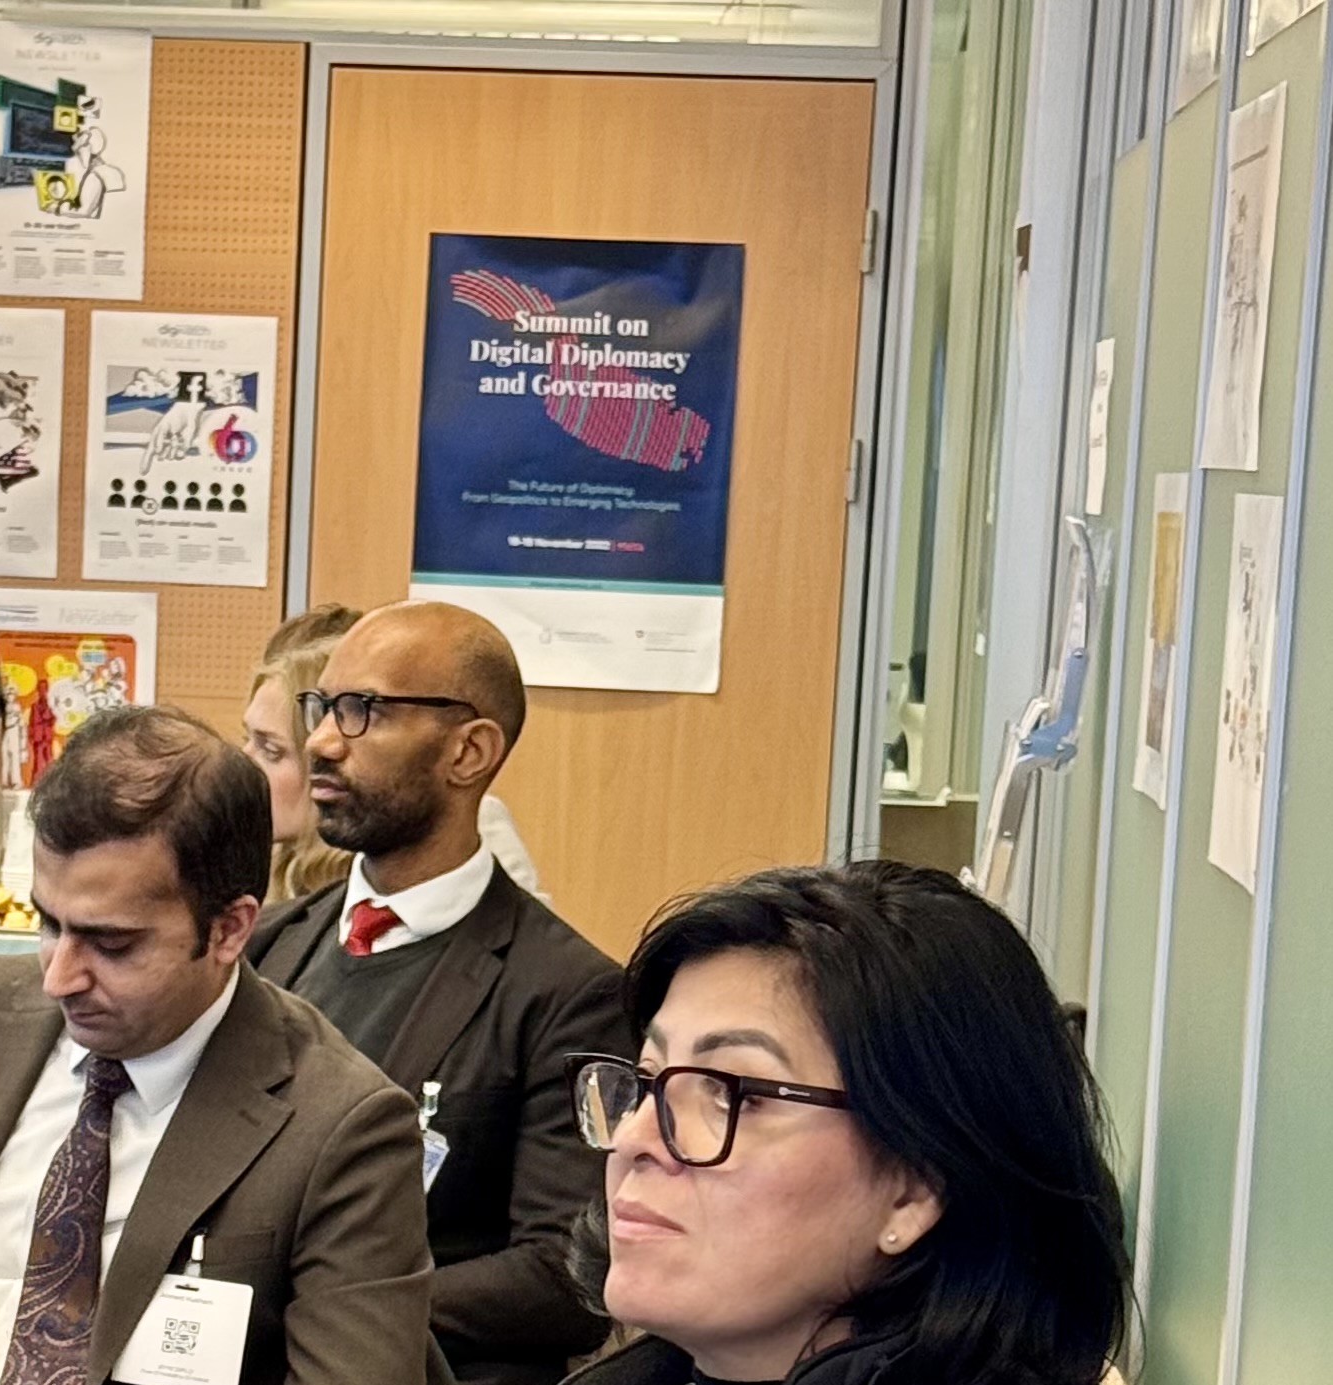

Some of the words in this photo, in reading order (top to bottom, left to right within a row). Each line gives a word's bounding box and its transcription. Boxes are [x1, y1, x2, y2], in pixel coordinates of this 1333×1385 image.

[513, 310, 612, 336] Summit
[617, 316, 649, 337] on
[469, 338, 553, 367] Digital
[561, 343, 691, 373] Diplomacy
[478, 373, 526, 396] and
[531, 374, 677, 402] Governance
[508, 479, 528, 492] The
[529, 480, 565, 494] Future
[566, 482, 579, 494] of
[461, 490, 489, 504] From
[549, 496, 562, 506] to
[562, 496, 612, 511] Emerging
